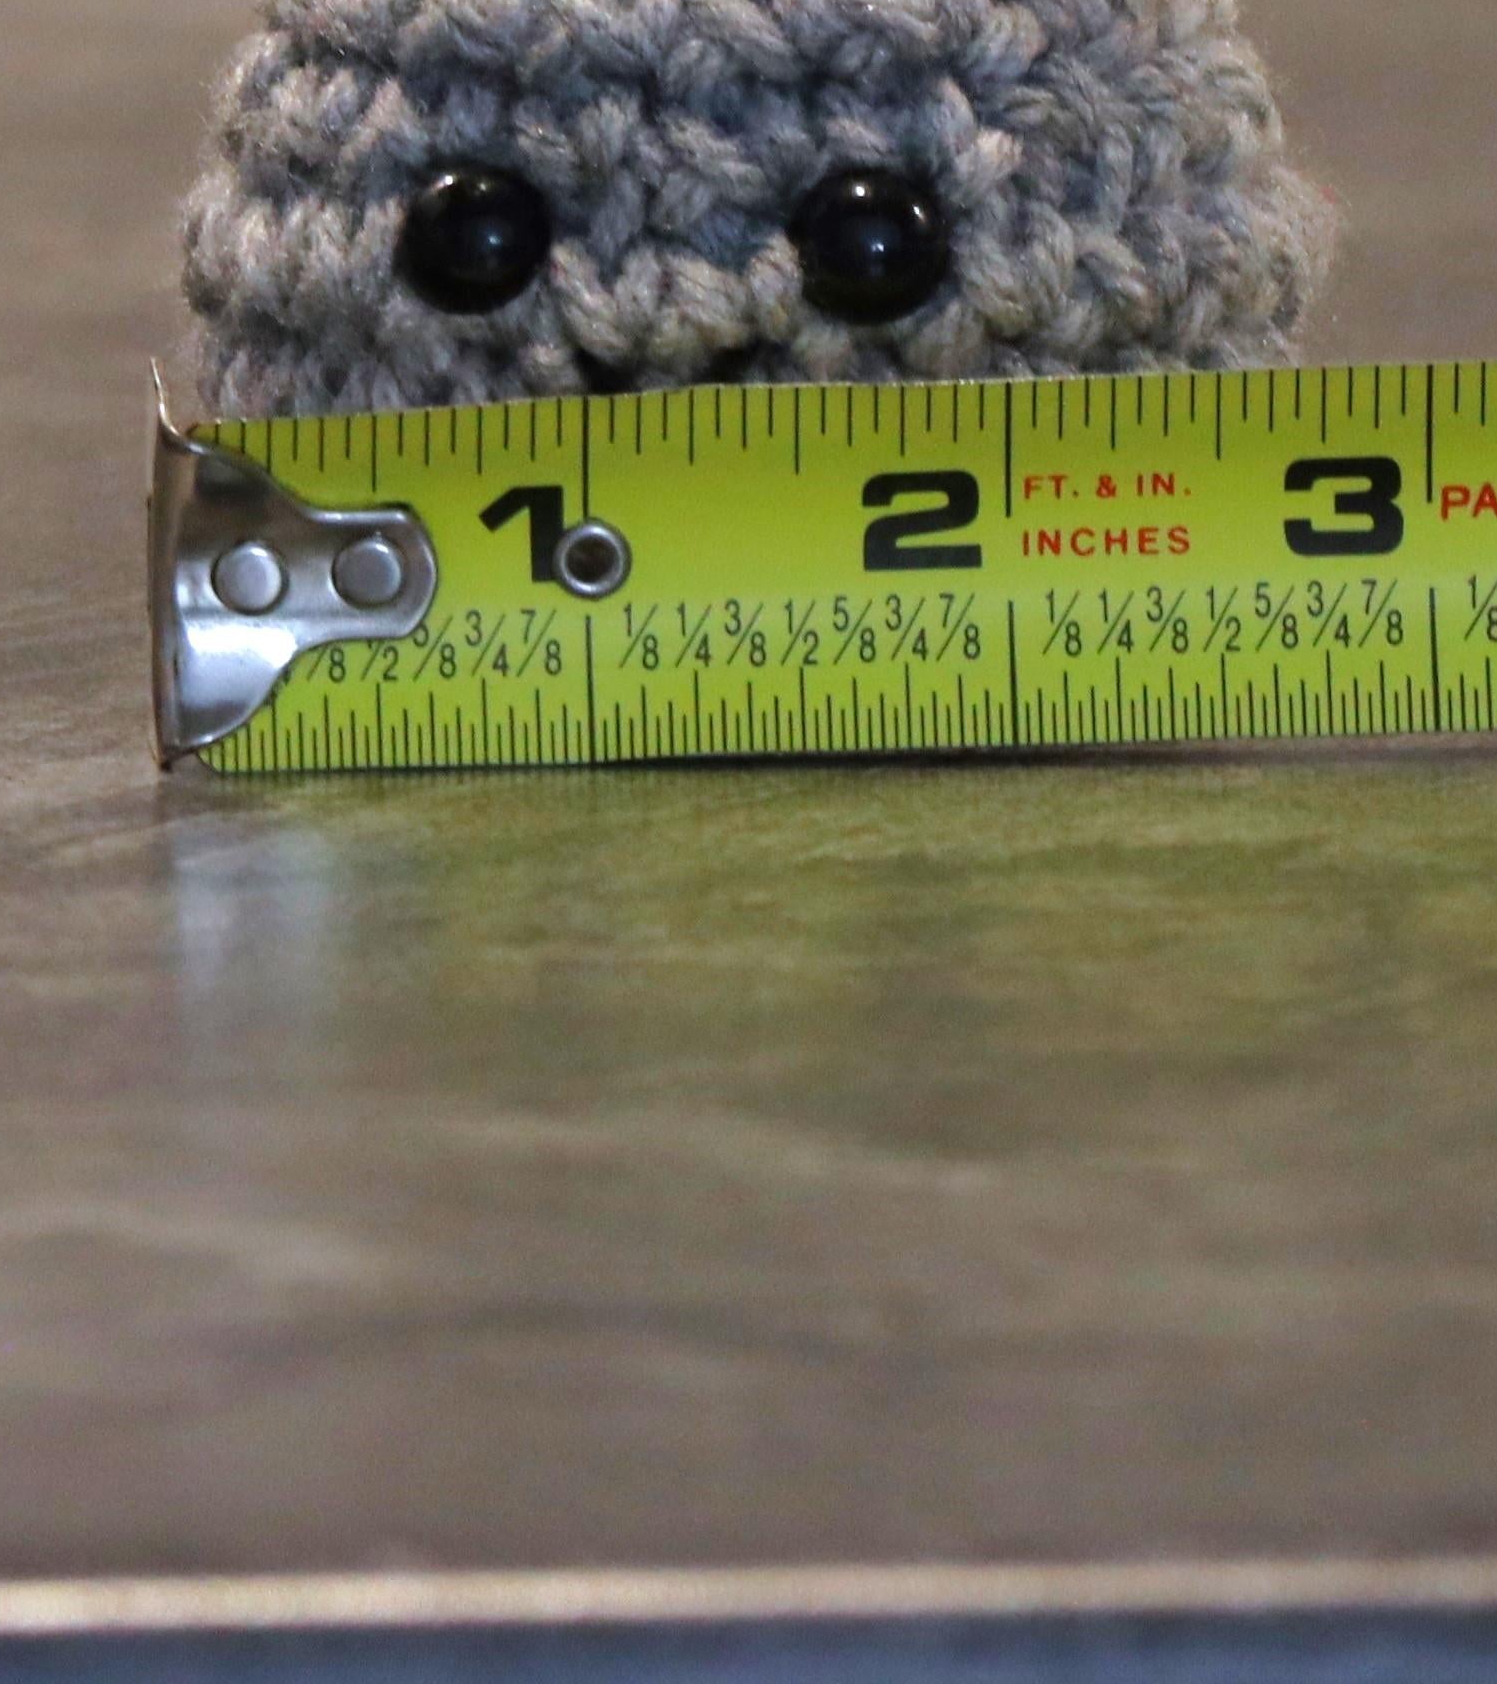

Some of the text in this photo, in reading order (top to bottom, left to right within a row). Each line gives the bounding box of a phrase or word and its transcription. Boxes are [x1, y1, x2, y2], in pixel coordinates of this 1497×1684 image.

[478, 484, 565, 584] 1
[862, 470, 983, 572] 2
[1023, 474, 1192, 501] FT. & IN.
[1283, 456, 1404, 557] 3
[1022, 528, 1192, 558] INCHES
